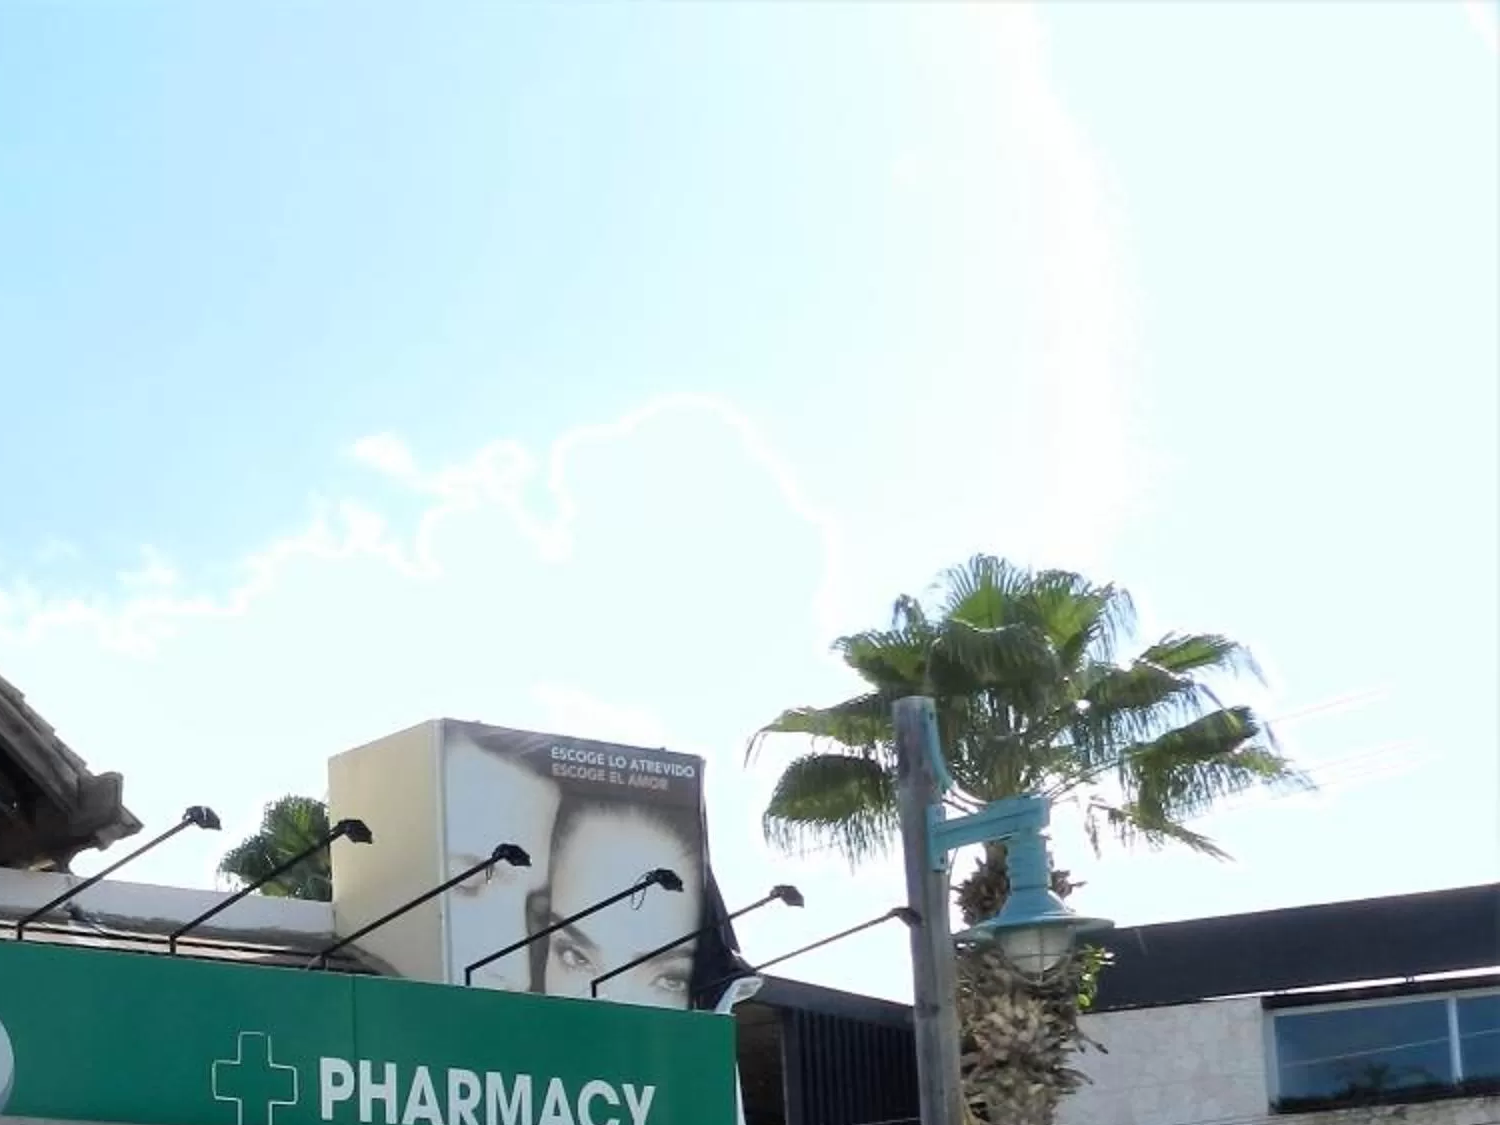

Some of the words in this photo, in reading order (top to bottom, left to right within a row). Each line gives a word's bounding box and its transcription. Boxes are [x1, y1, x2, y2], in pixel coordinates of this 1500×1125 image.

[551, 746, 605, 765] ESCOGE
[608, 755, 627, 769] LO
[629, 759, 695, 777] ATREVIDO
[551, 763, 606, 782] ESCOGE
[609, 771, 625, 784] EL
